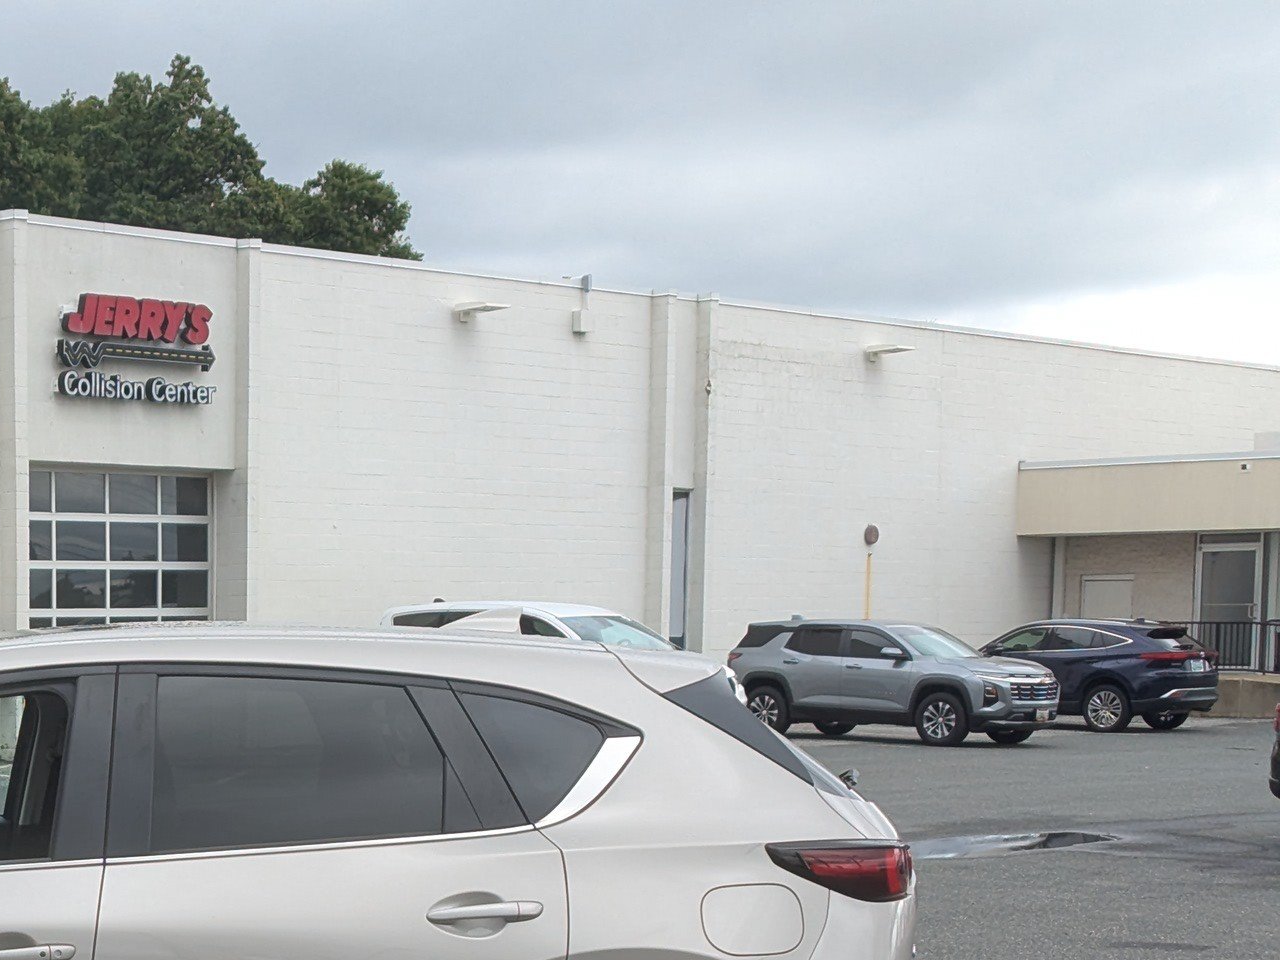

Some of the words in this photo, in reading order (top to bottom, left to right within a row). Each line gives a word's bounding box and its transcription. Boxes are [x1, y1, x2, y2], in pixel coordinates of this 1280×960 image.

[65, 293, 213, 345] JERRY'S
[61, 370, 146, 401] Collision
[150, 376, 217, 405] Center
